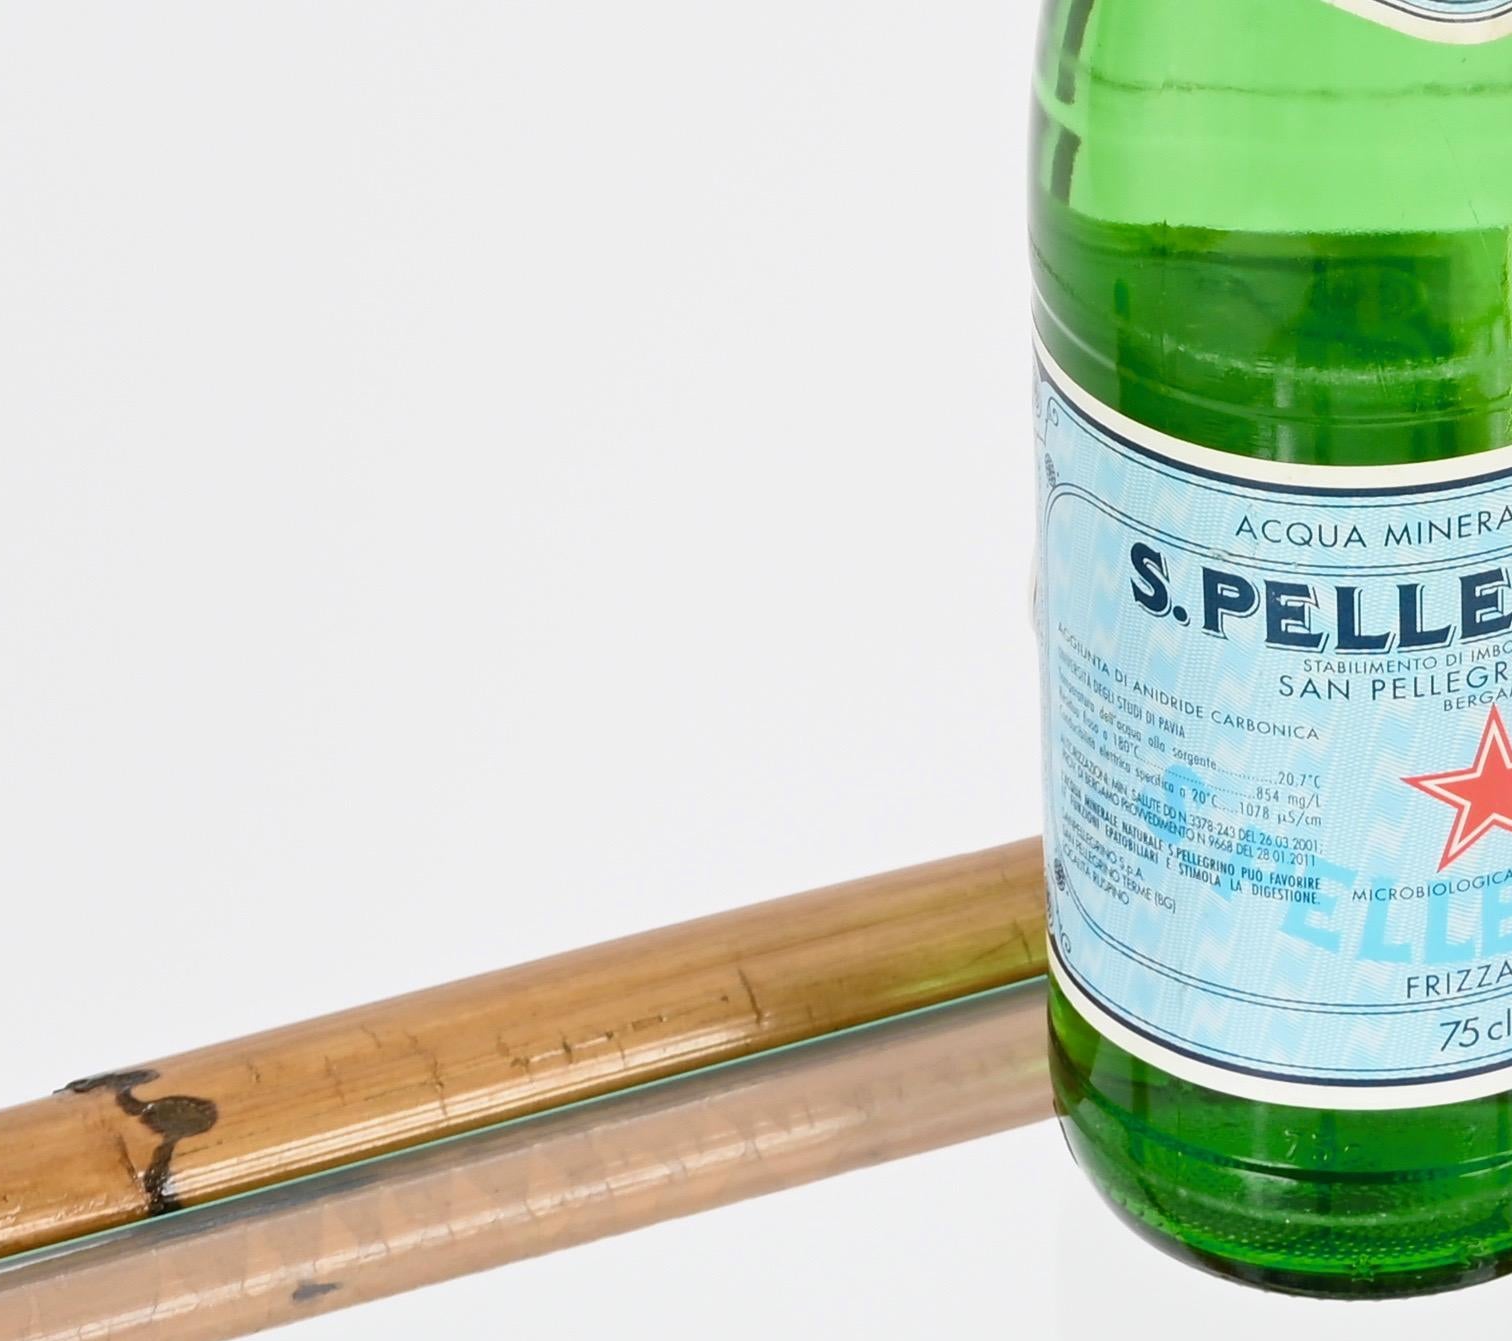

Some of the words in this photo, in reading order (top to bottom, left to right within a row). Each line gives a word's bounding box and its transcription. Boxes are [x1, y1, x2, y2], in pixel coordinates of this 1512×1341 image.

[1235, 515, 1367, 548] ACQUA
[1303, 655, 1437, 675] STABILIMENTO
[1446, 651, 1463, 668] DI
[1279, 674, 1350, 702] SAN
[1115, 668, 1127, 687] DI
[1132, 680, 1204, 718] ANIDRIDE
[1211, 710, 1320, 740] CARBONICA
[1117, 694, 1142, 721] STUDI
[1158, 716, 1186, 740] PAVIA
[1256, 786, 1280, 803] 854
[1238, 801, 1270, 820] 1078
[1239, 827, 1257, 844] DEL
[1236, 843, 1254, 858] DEL
[1166, 858, 1172, 870] E
[1178, 862, 1221, 888] STIMOLA
[1230, 877, 1243, 894] LA
[1269, 873, 1321, 891] FAVORIRE
